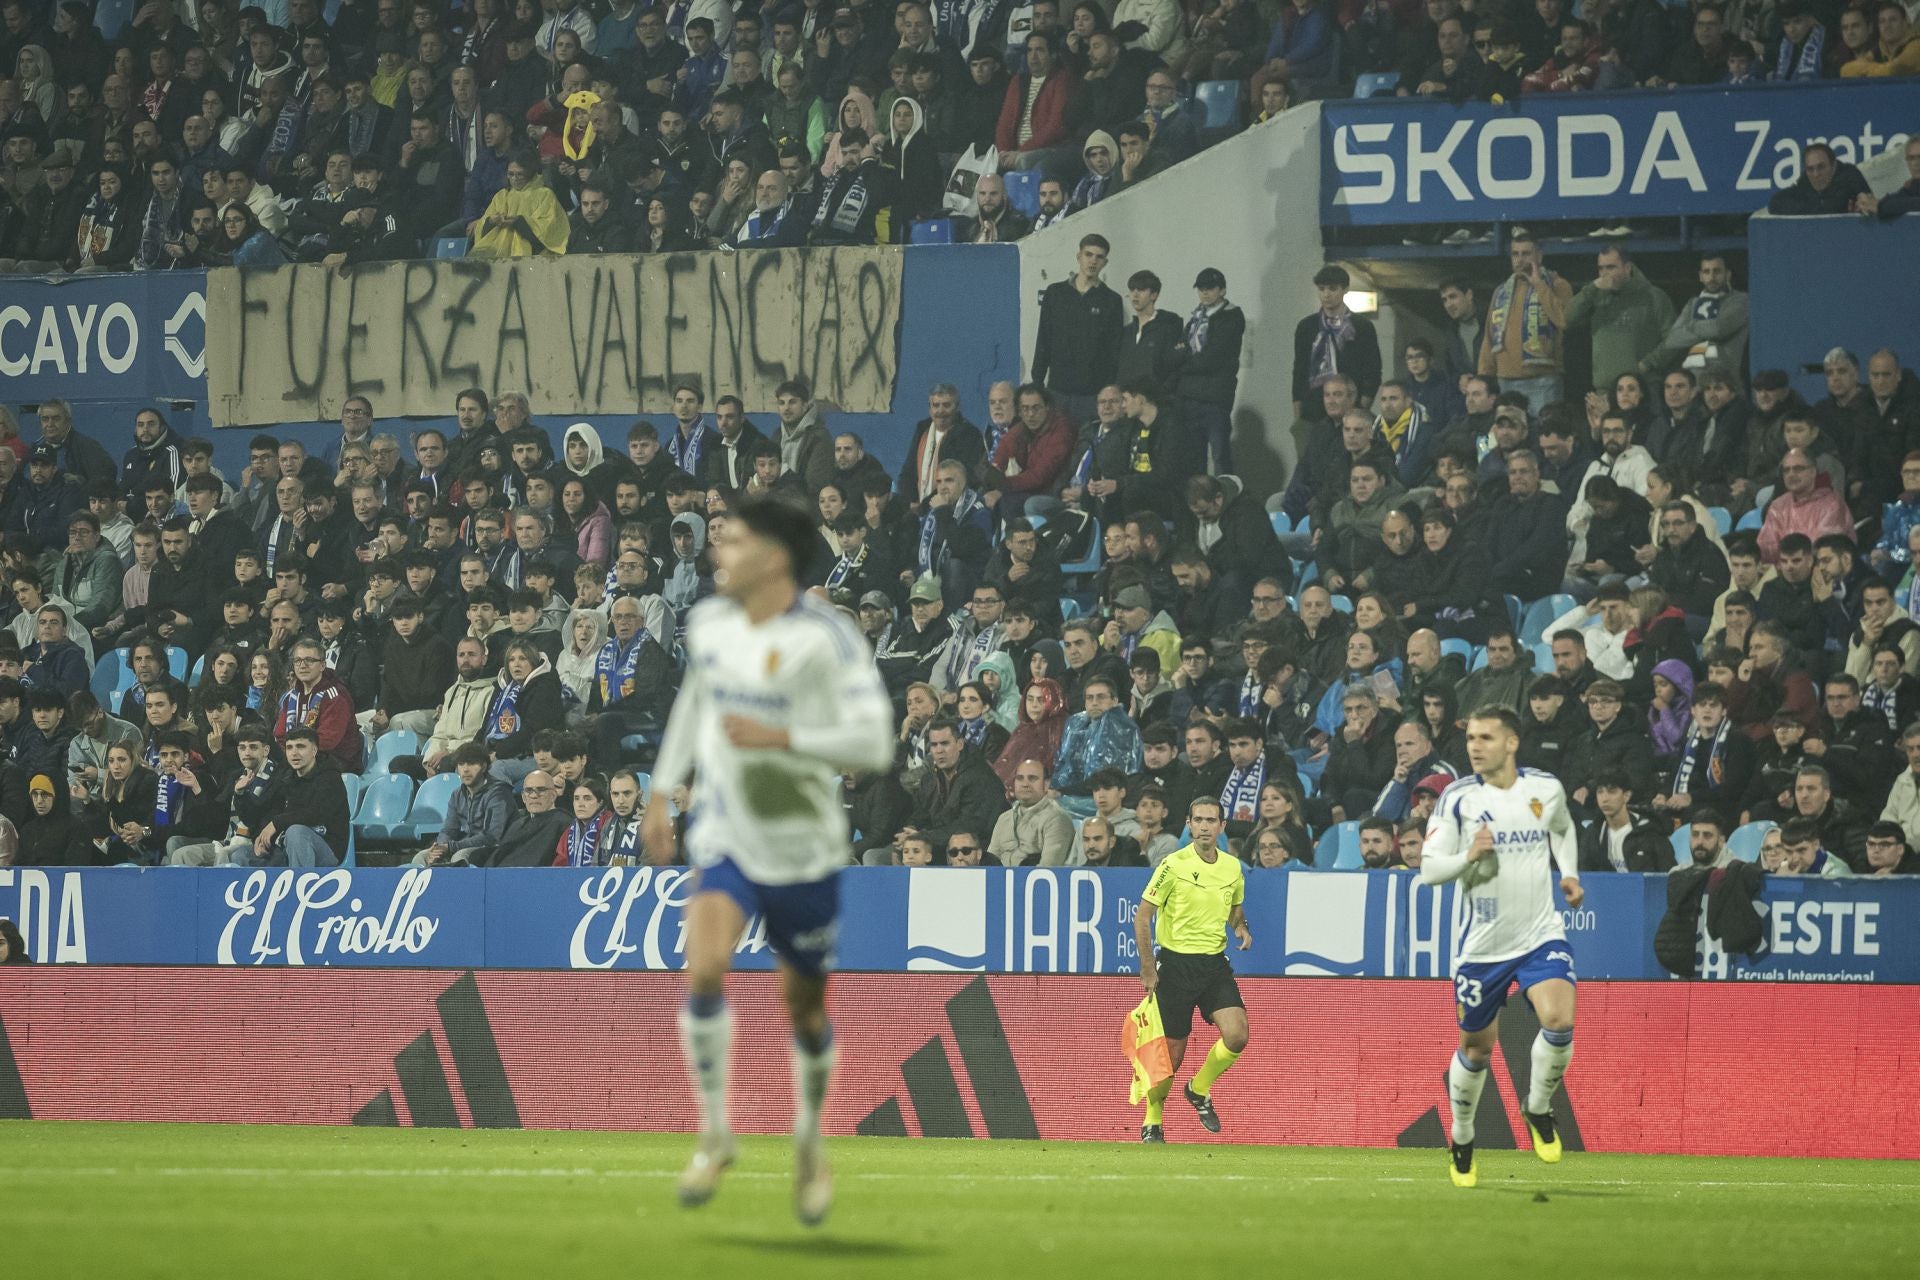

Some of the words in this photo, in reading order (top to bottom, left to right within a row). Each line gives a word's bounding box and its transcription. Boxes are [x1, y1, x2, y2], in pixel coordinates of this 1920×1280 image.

[1332, 110, 1709, 206] SKODA
[0, 301, 139, 377] CAYO
[238, 261, 533, 402] FUERZA
[565, 248, 843, 406] VALENCIA
[217, 869, 295, 965] El
[286, 868, 439, 965] Criollo
[569, 866, 653, 968] El
[1004, 868, 1104, 974] IAR
[1456, 974, 1482, 1008] 23
